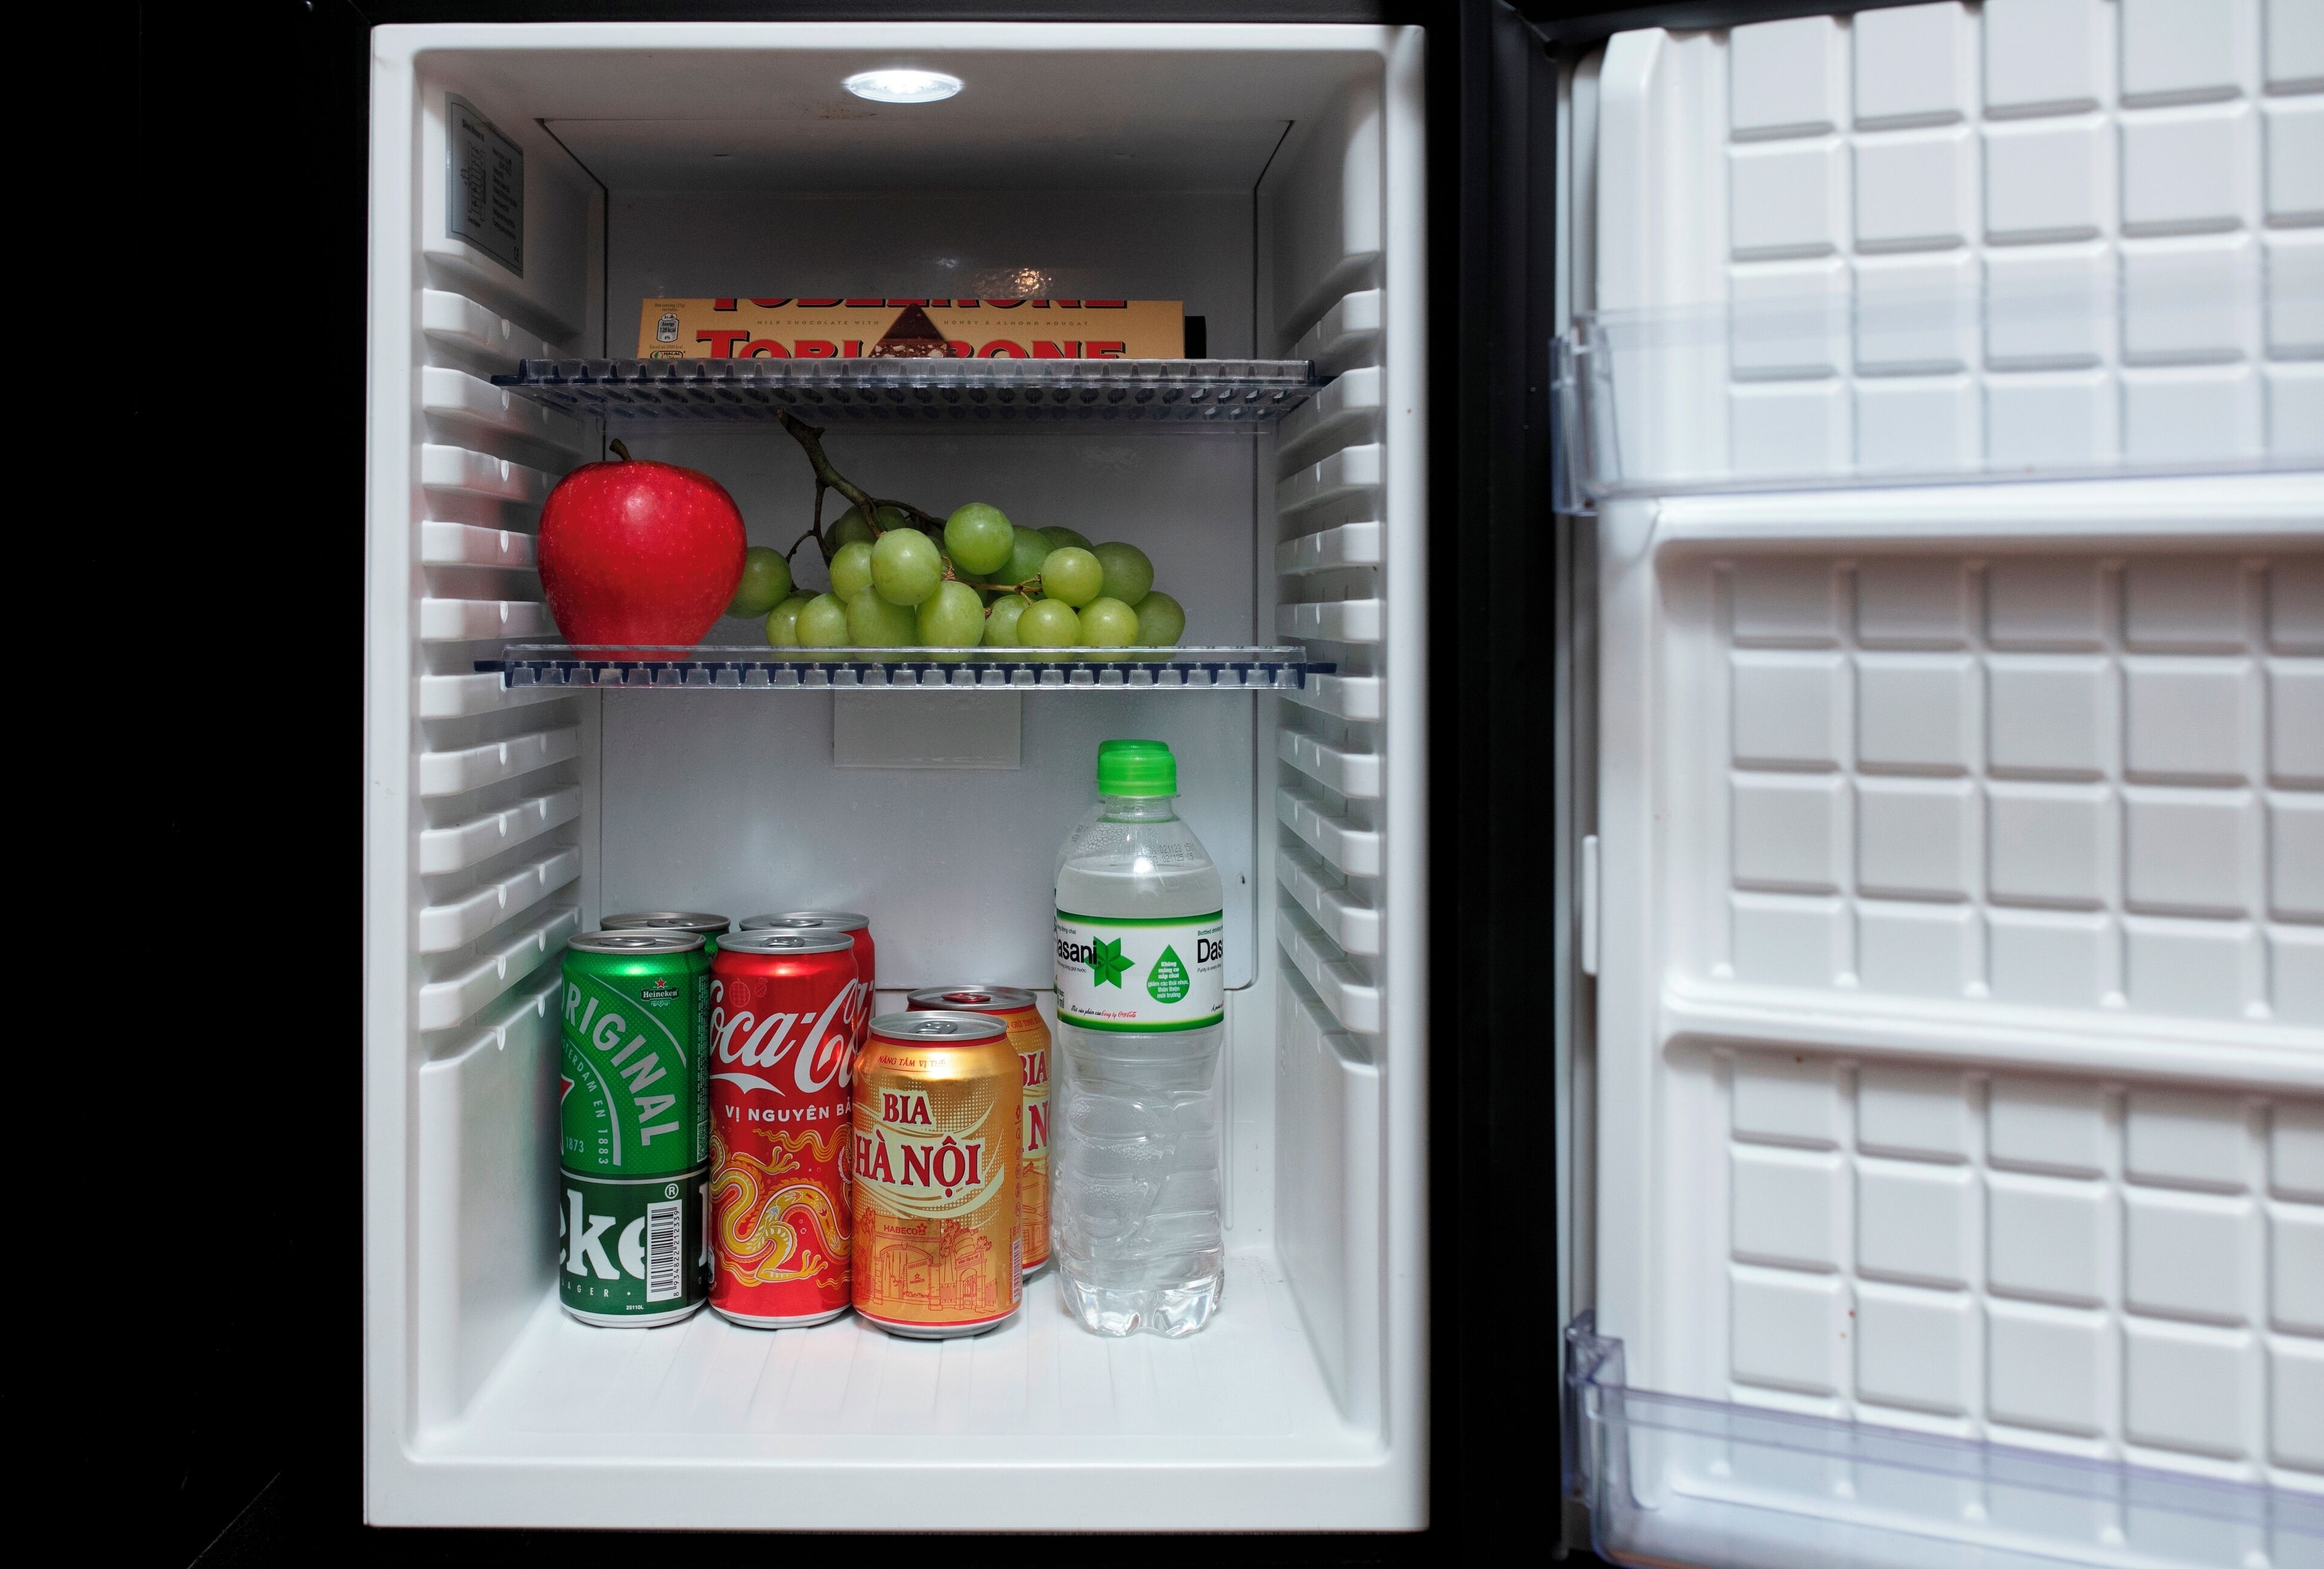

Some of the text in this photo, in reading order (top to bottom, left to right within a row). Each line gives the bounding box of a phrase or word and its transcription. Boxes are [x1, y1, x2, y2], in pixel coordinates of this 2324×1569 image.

[1057, 939, 1097, 964] asani
[1198, 938, 1223, 963] Das
[643, 989, 678, 999] Heineken
[561, 972, 680, 1146] RIGINAL
[593, 1100, 606, 1118] EN
[725, 1105, 740, 1122] VỊ
[748, 1105, 829, 1122] NGUYÊN
[883, 1093, 932, 1125] BIA
[1028, 1100, 1051, 1151] N
[566, 1136, 584, 1153] 1873
[598, 1129, 608, 1165] 1883
[856, 1129, 980, 1198] HÀ NỘI
[884, 1225, 917, 1235] HABECO
